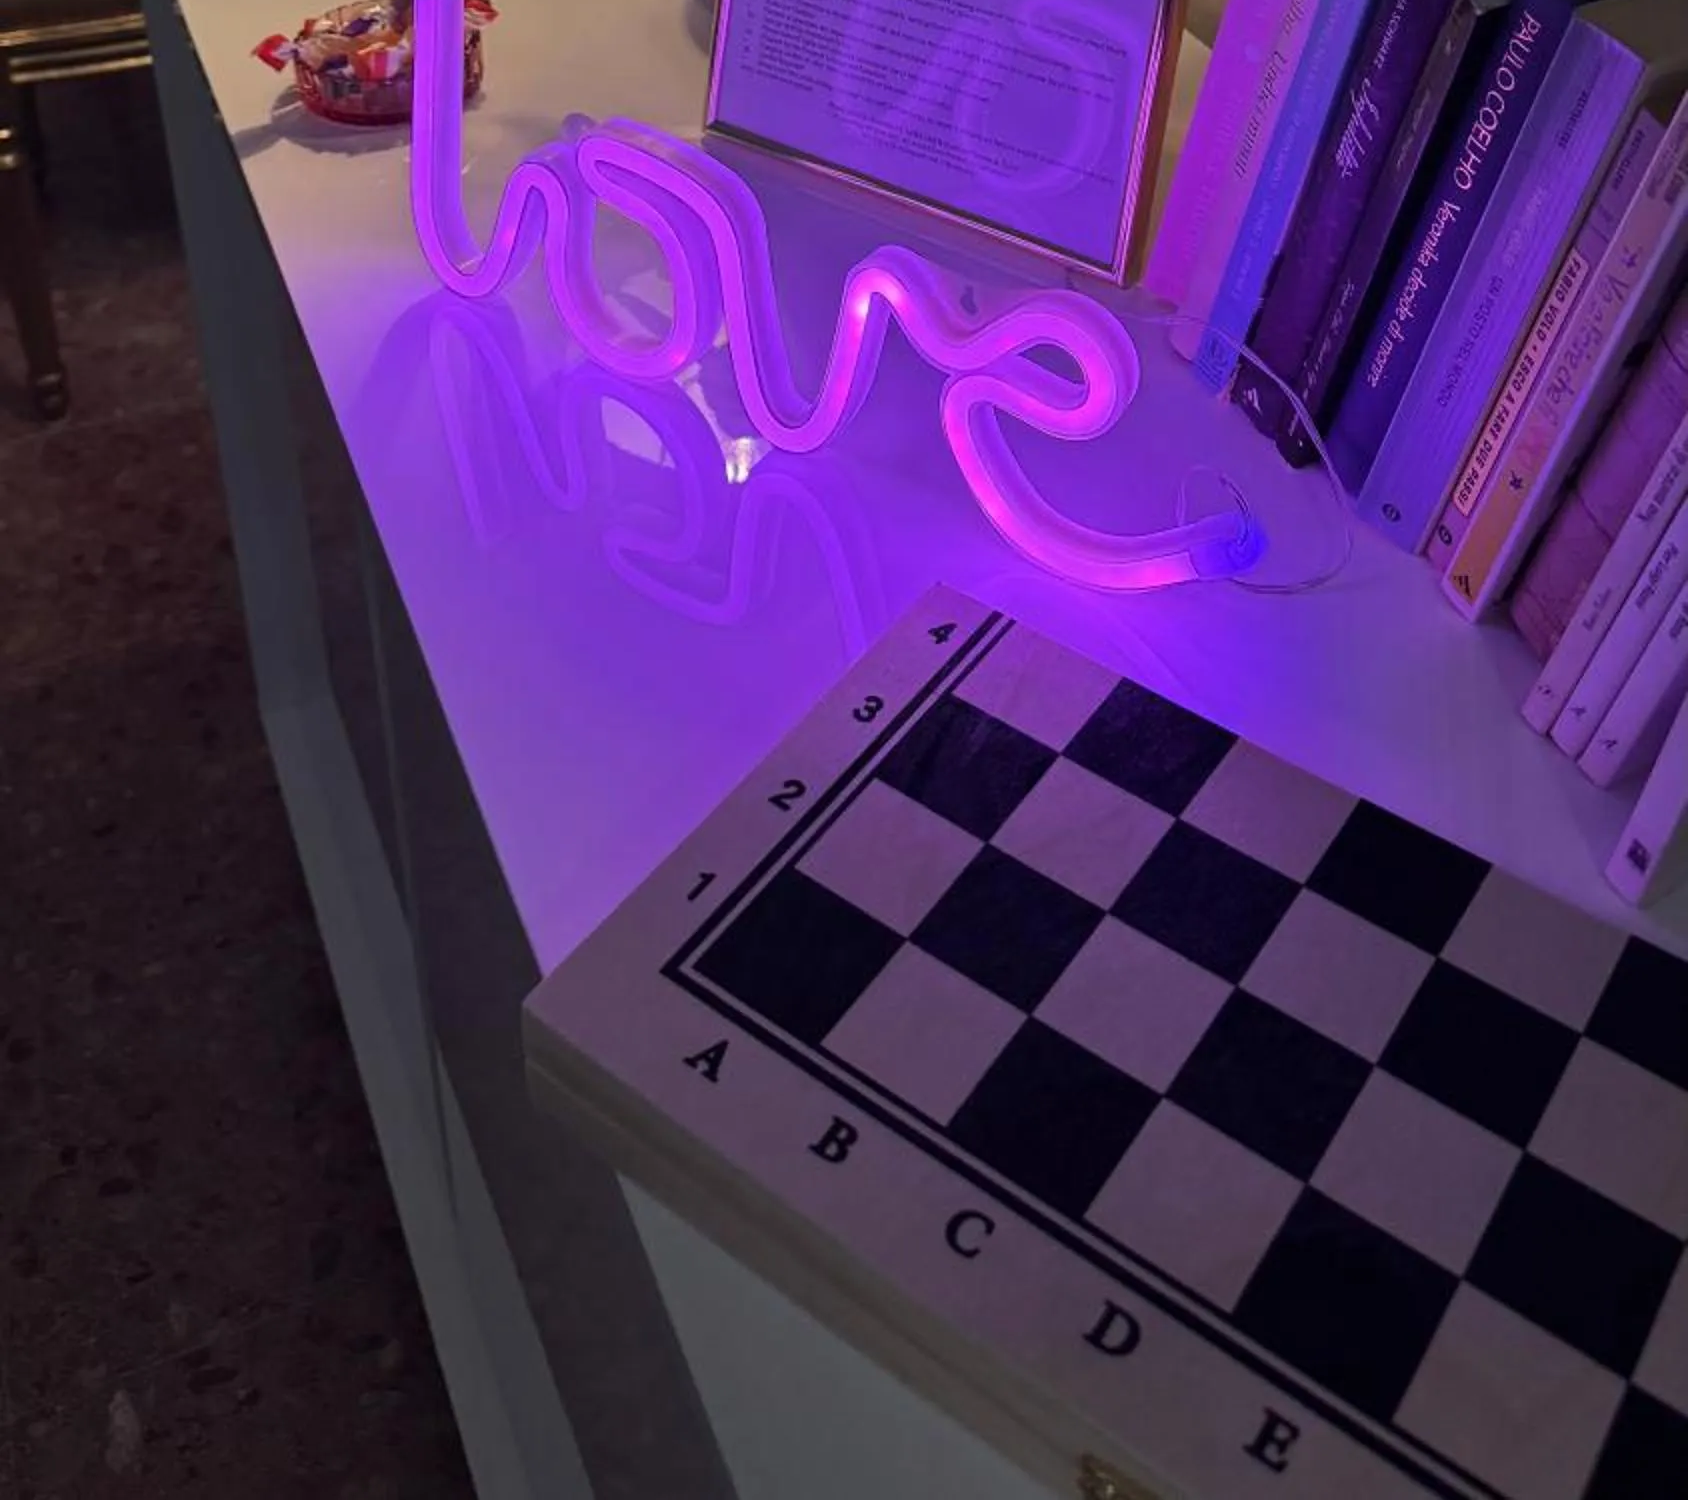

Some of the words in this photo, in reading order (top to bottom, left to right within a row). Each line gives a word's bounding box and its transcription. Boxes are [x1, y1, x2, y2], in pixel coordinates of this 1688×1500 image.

[1494, 9, 1544, 92] PAULO
[1453, 89, 1507, 191] COELHO
[1417, 198, 1462, 267] Veronika
[1397, 265, 1429, 323] decide
[1554, 257, 1583, 303] FABIO
[1386, 317, 1407, 342] di
[1534, 303, 1562, 342] VOLO
[1509, 354, 1536, 391] ESCO
[1487, 405, 1512, 439] FARE
[1473, 439, 1495, 468] DUE
[1457, 467, 1483, 505] PASSI
[928, 621, 958, 645] 4
[852, 694, 884, 724] 3
[767, 778, 807, 811] 2
[686, 871, 717, 902] 1
[682, 1038, 730, 1084] A
[808, 1115, 859, 1165] B
[944, 1208, 996, 1258] C
[1081, 1299, 1143, 1358] D
[1242, 1405, 1301, 1474] E
